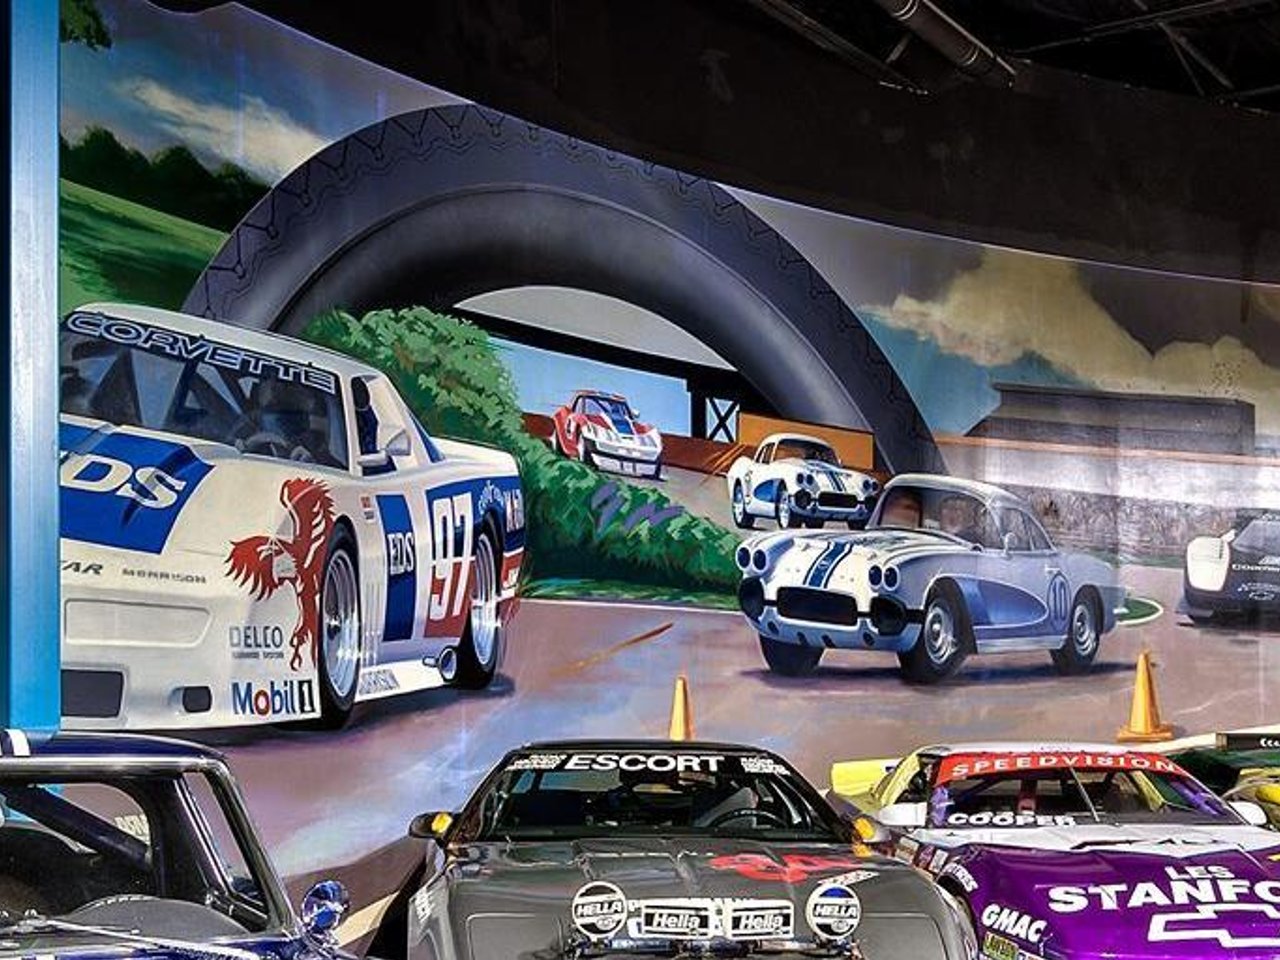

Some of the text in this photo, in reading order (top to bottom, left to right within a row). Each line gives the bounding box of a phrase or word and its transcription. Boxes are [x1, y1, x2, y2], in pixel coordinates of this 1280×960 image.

[66, 312, 337, 395] CORVETTE
[60, 450, 185, 509] DS
[386, 531, 415, 576] EDS
[428, 491, 473, 621] 97
[229, 625, 284, 649] DELCO
[231, 680, 316, 716] Mobil 1
[564, 754, 724, 772] ESCORT
[952, 754, 1176, 778] SPEEDVISION
[947, 811, 1076, 827] COOPER
[1165, 865, 1236, 881] LES
[577, 901, 623, 917] HELLA
[652, 912, 701, 930] Hella
[814, 903, 858, 918] HELLA
[739, 912, 784, 931] Hella
[981, 903, 1048, 944] GMAC
